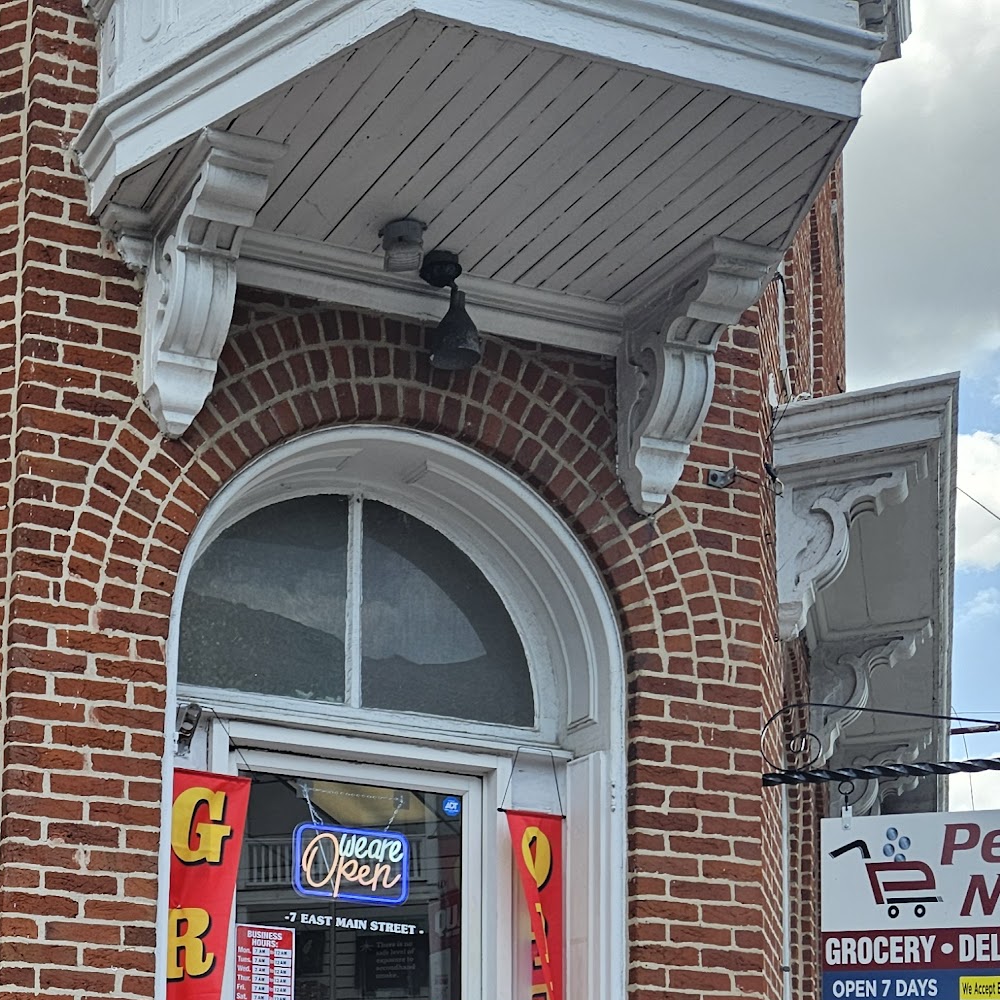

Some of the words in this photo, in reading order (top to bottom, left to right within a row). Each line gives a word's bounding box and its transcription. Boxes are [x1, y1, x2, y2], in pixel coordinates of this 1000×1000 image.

[302, 833, 401, 898] Open
[301, 914, 333, 926] EAST
[335, 918, 367, 930] MAIN
[370, 922, 416, 935] STREET
[247, 930, 282, 940] BUSINESS
[252, 939, 278, 947] HOURS:
[825, 935, 935, 966] GROCERY
[832, 979, 877, 998] OPEN
[881, 979, 891, 996] 7
[895, 978, 938, 997] DAYS
[962, 983, 972, 995] We
[974, 982, 996, 997] Accept
